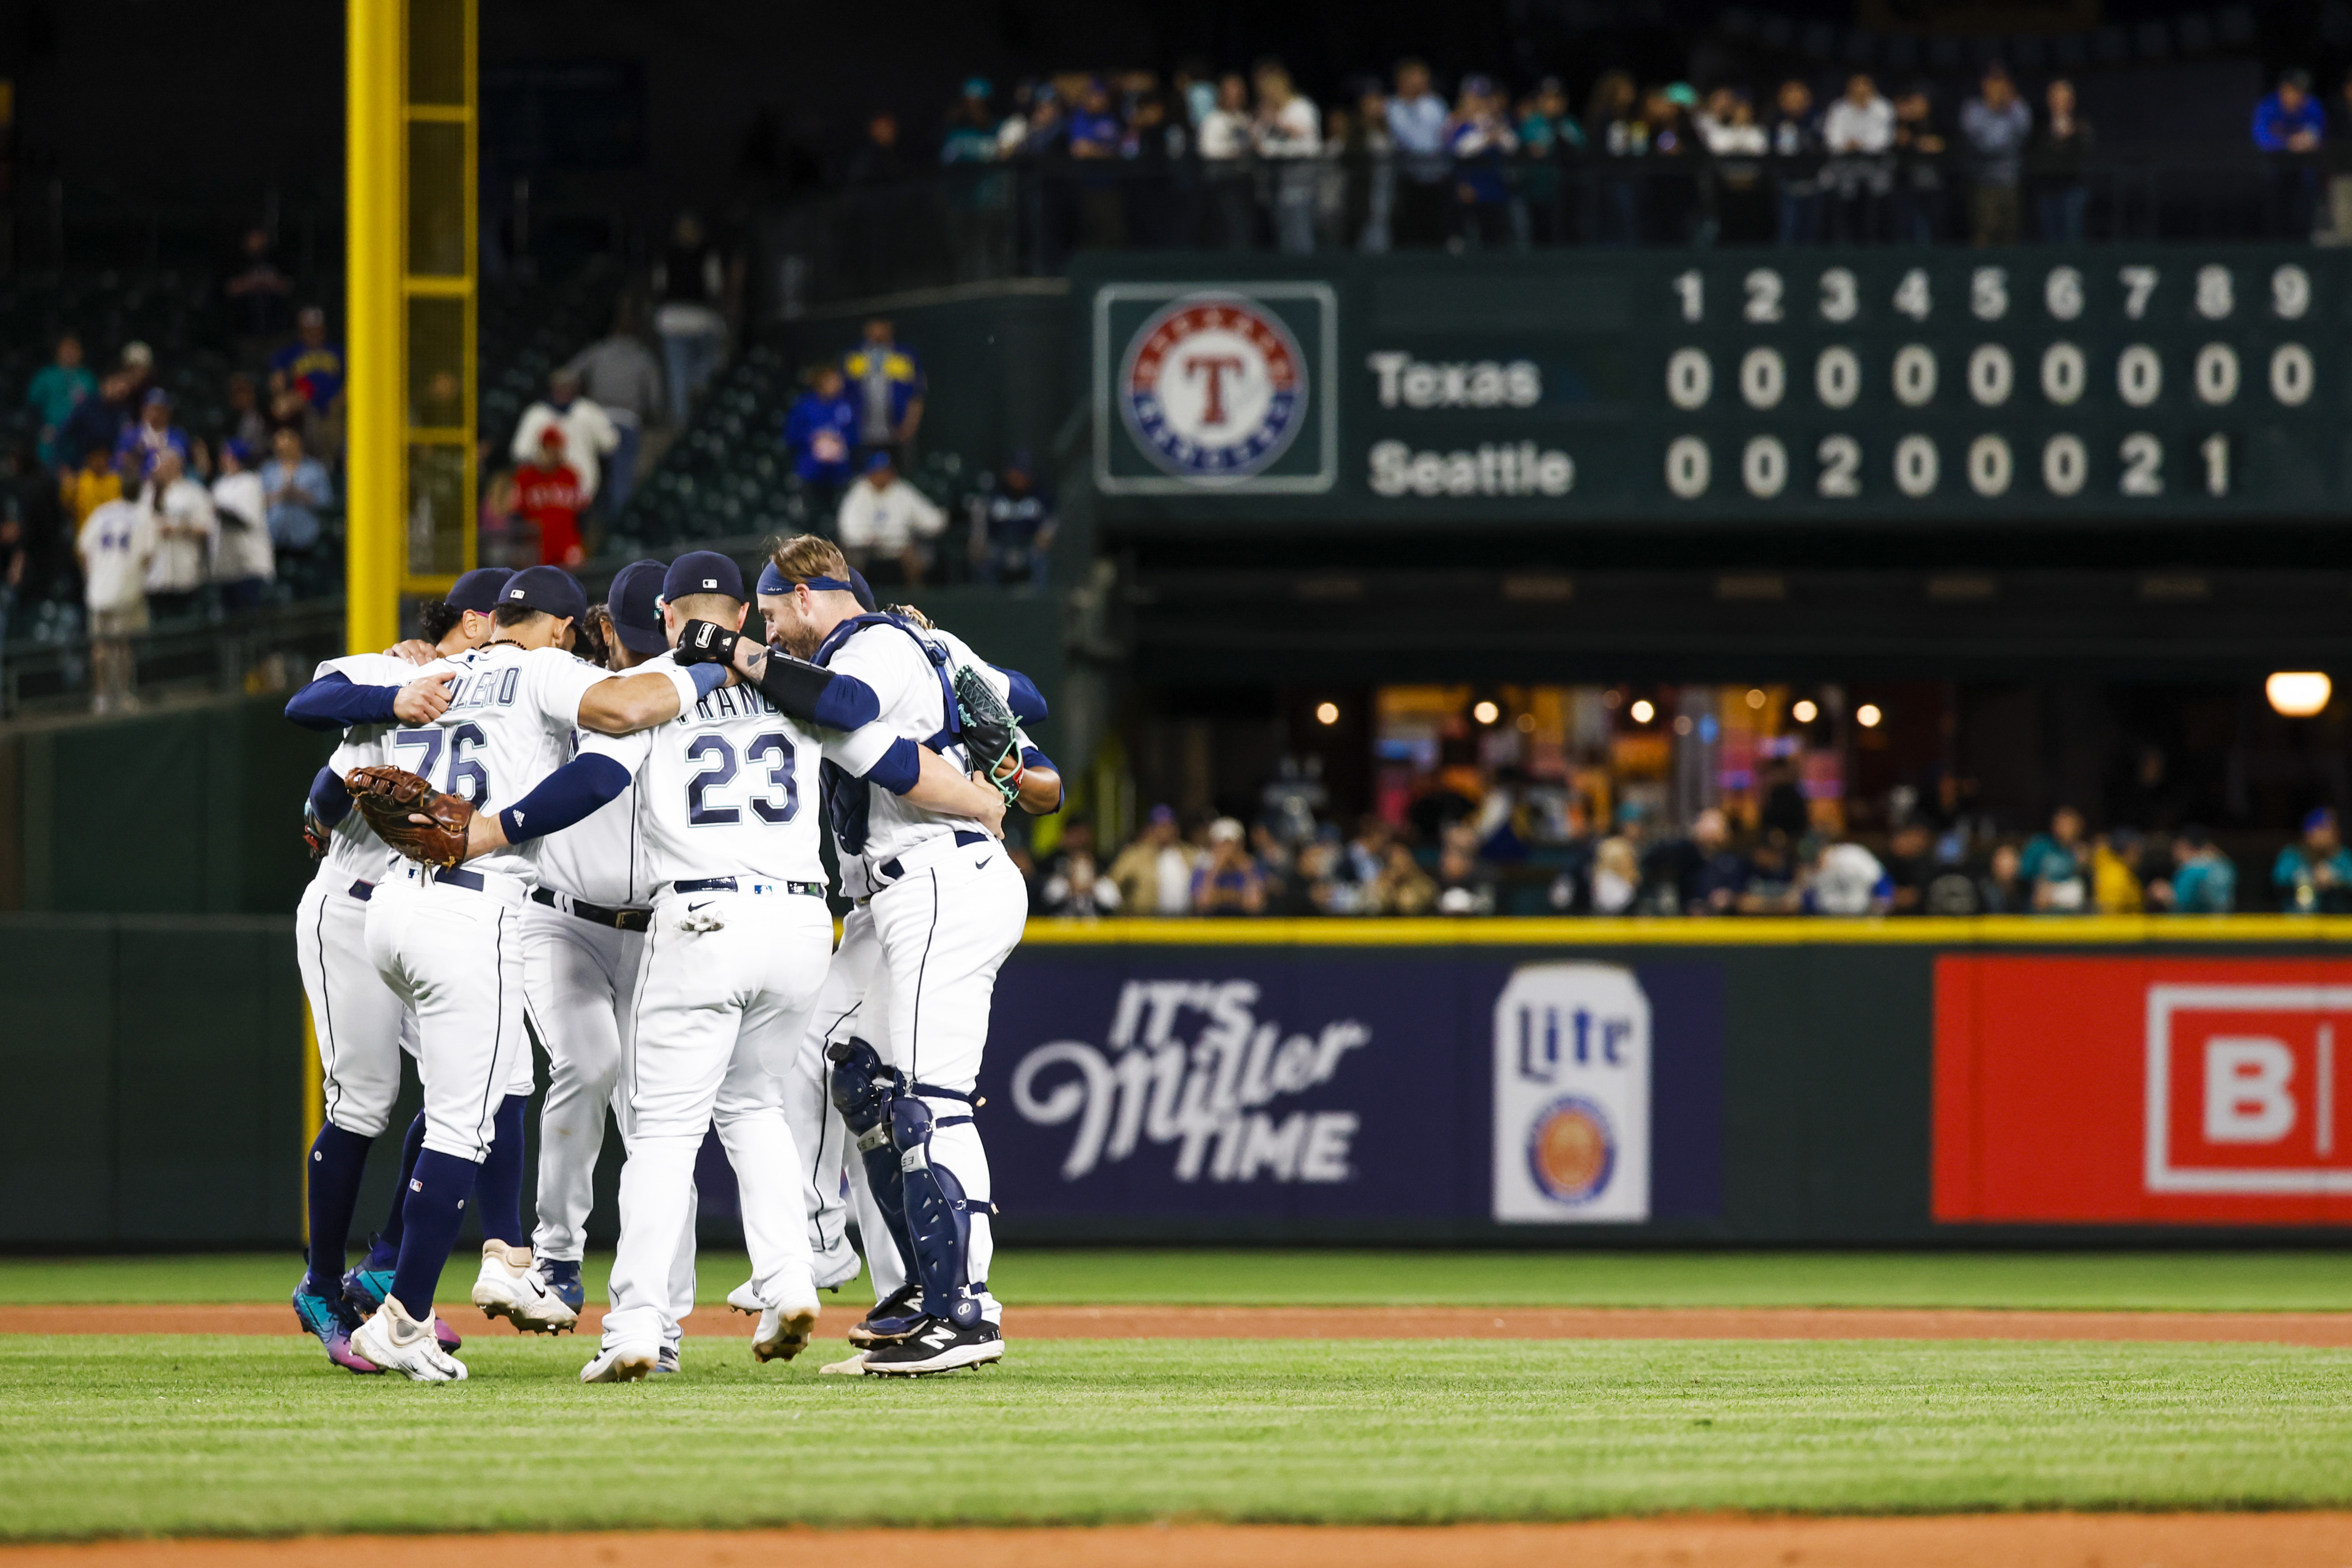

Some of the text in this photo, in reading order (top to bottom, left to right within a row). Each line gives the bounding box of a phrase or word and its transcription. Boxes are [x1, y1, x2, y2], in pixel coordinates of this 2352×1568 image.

[1673, 266, 2311, 322] 1 2 3 4 5 6 7 8 9
[1184, 356, 1243, 424] T
[1367, 343, 2314, 409] Texas 0 0 0 0 0 0 0 0 0
[1369, 434, 2228, 499] Seattle 0 0 2 0 0 0 2 1
[407, 665, 522, 713] LLERO
[394, 721, 491, 811] 76
[685, 730, 801, 828] 23
[1108, 978, 1262, 1050] IT'S
[1517, 1005, 1631, 1084] Lite
[1010, 1017, 1372, 1181] Miller
[2205, 1035, 2296, 1144] B
[1175, 1110, 1360, 1183] TIME
